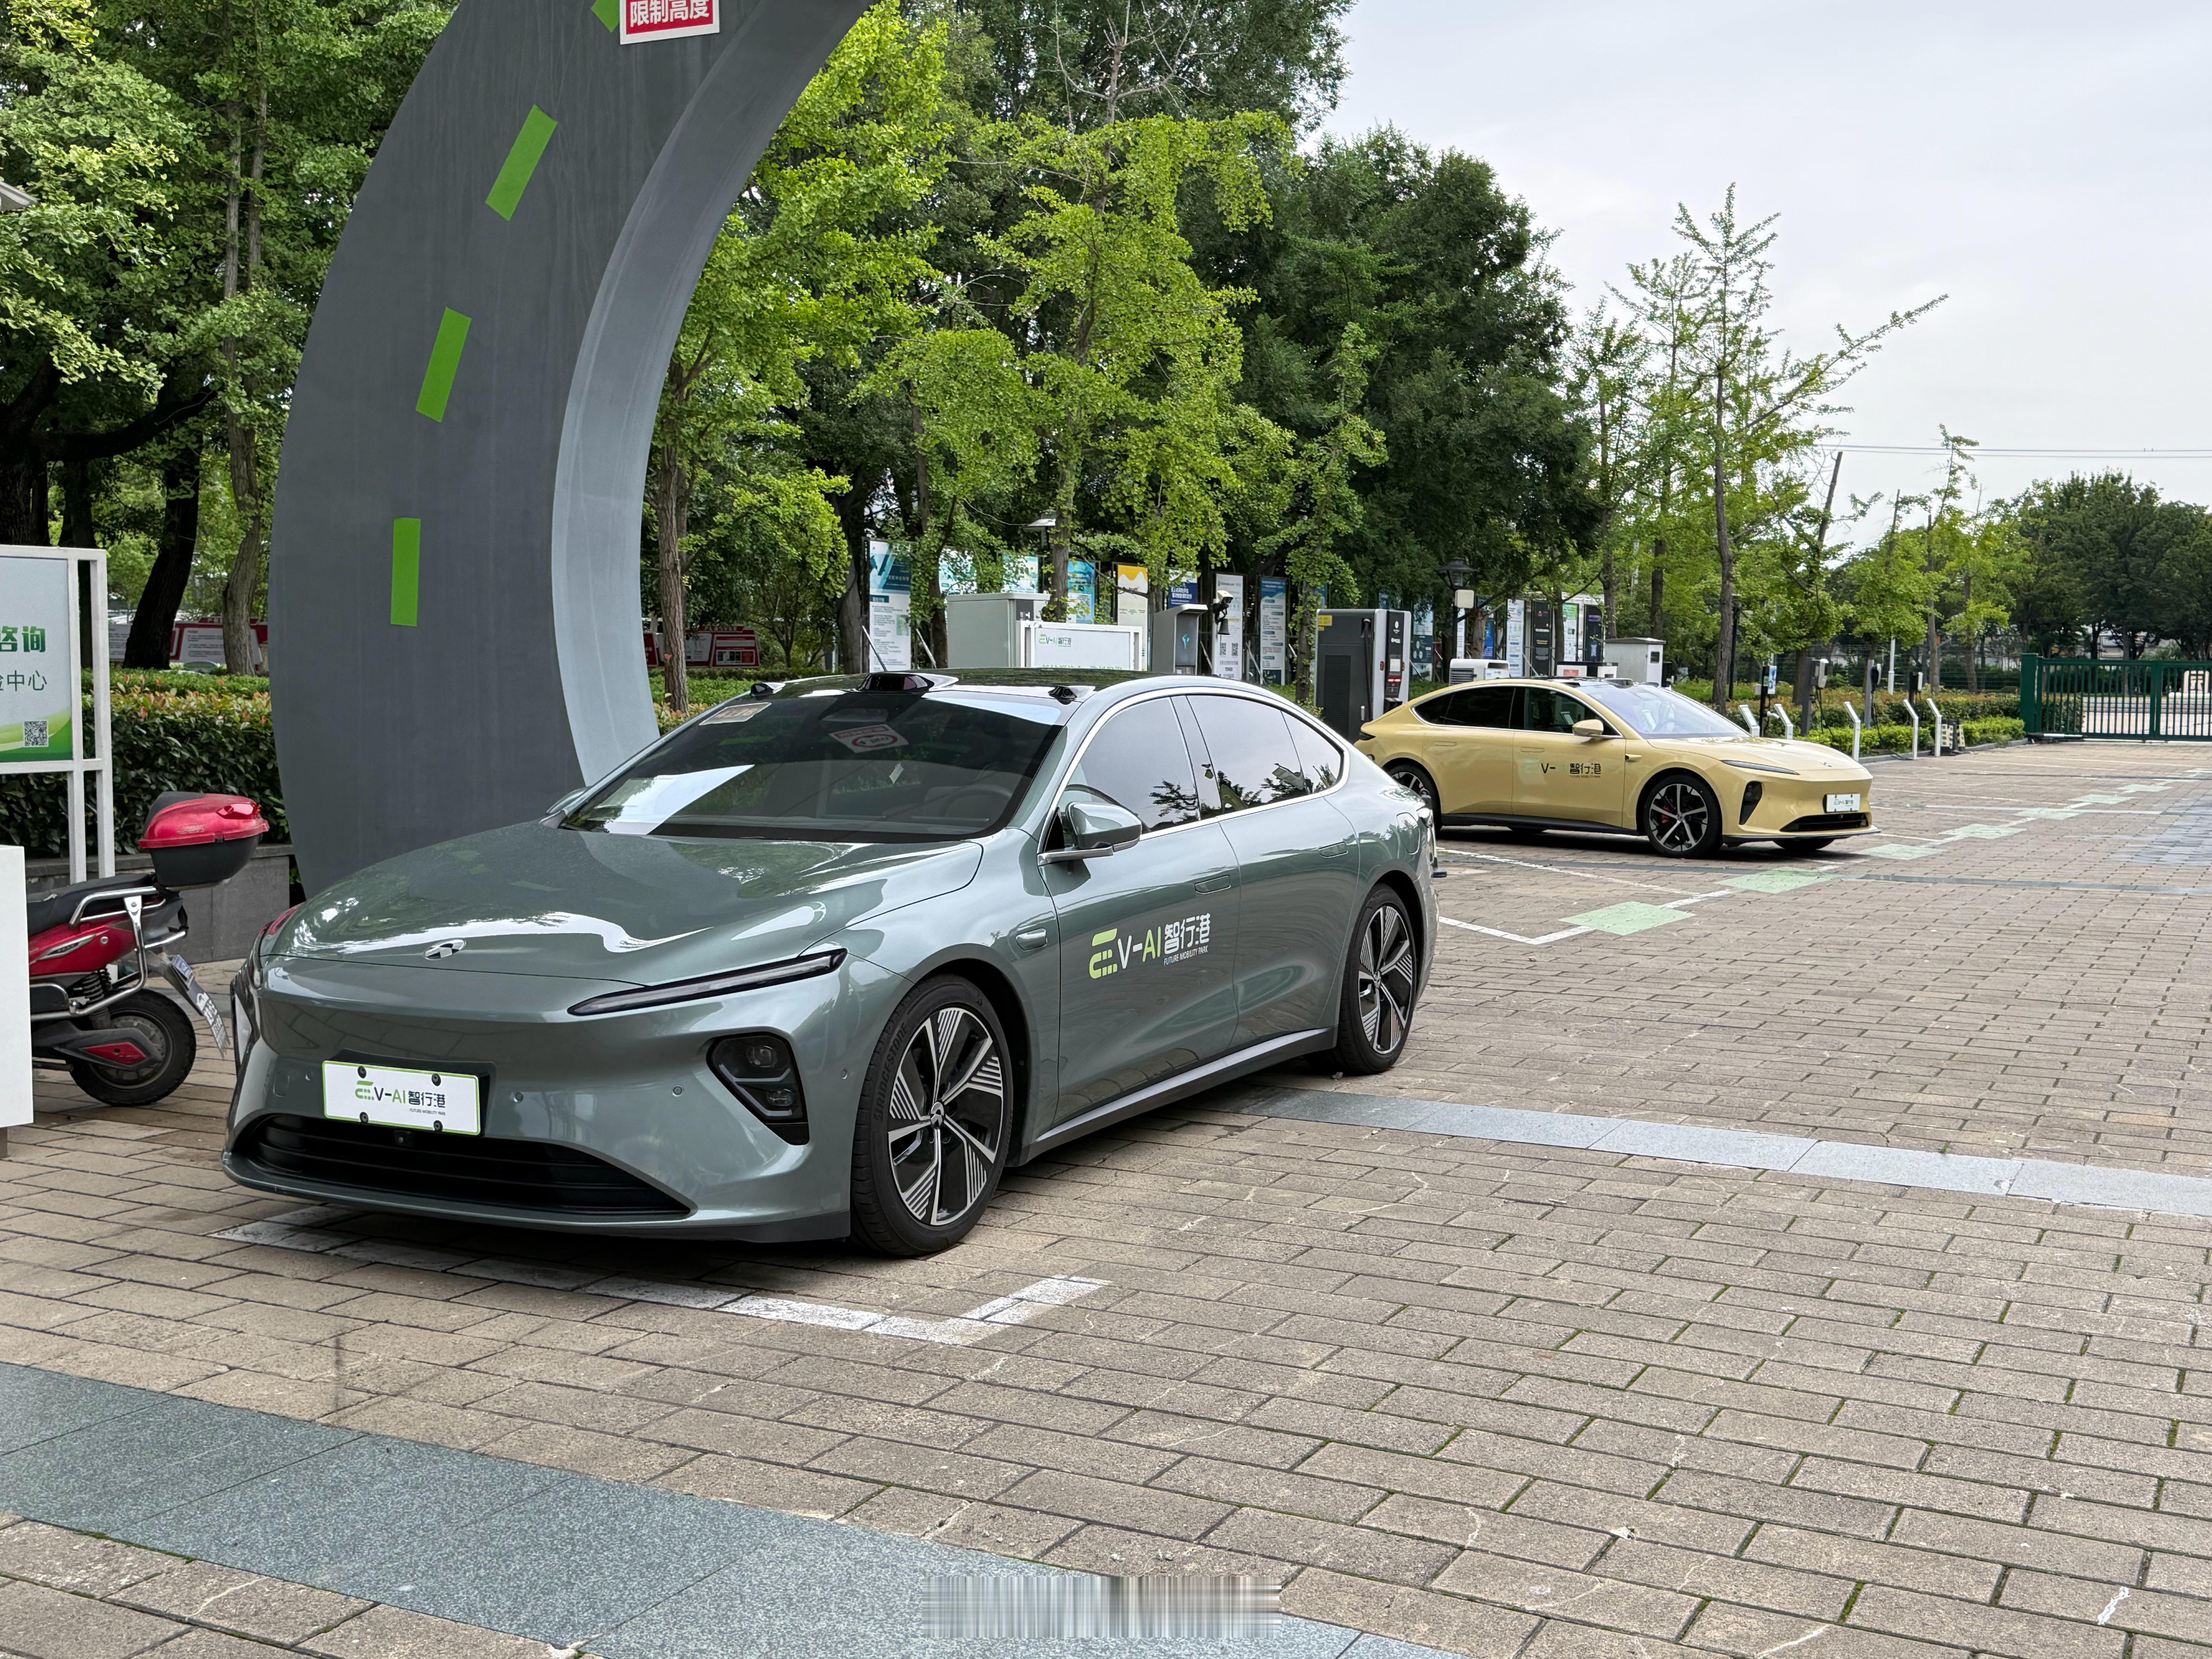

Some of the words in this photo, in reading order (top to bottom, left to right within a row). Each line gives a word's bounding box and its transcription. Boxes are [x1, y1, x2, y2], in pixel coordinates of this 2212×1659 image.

[630, 0, 709, 27] 限制高度
[0, 670, 47, 692] 中心
[1164, 954, 1179, 965] FUTURE
[1180, 948, 1198, 960] MOBILITY
[1198, 945, 1208, 954] PARK
[874, 1022, 908, 1121] BRIDGESTONE
